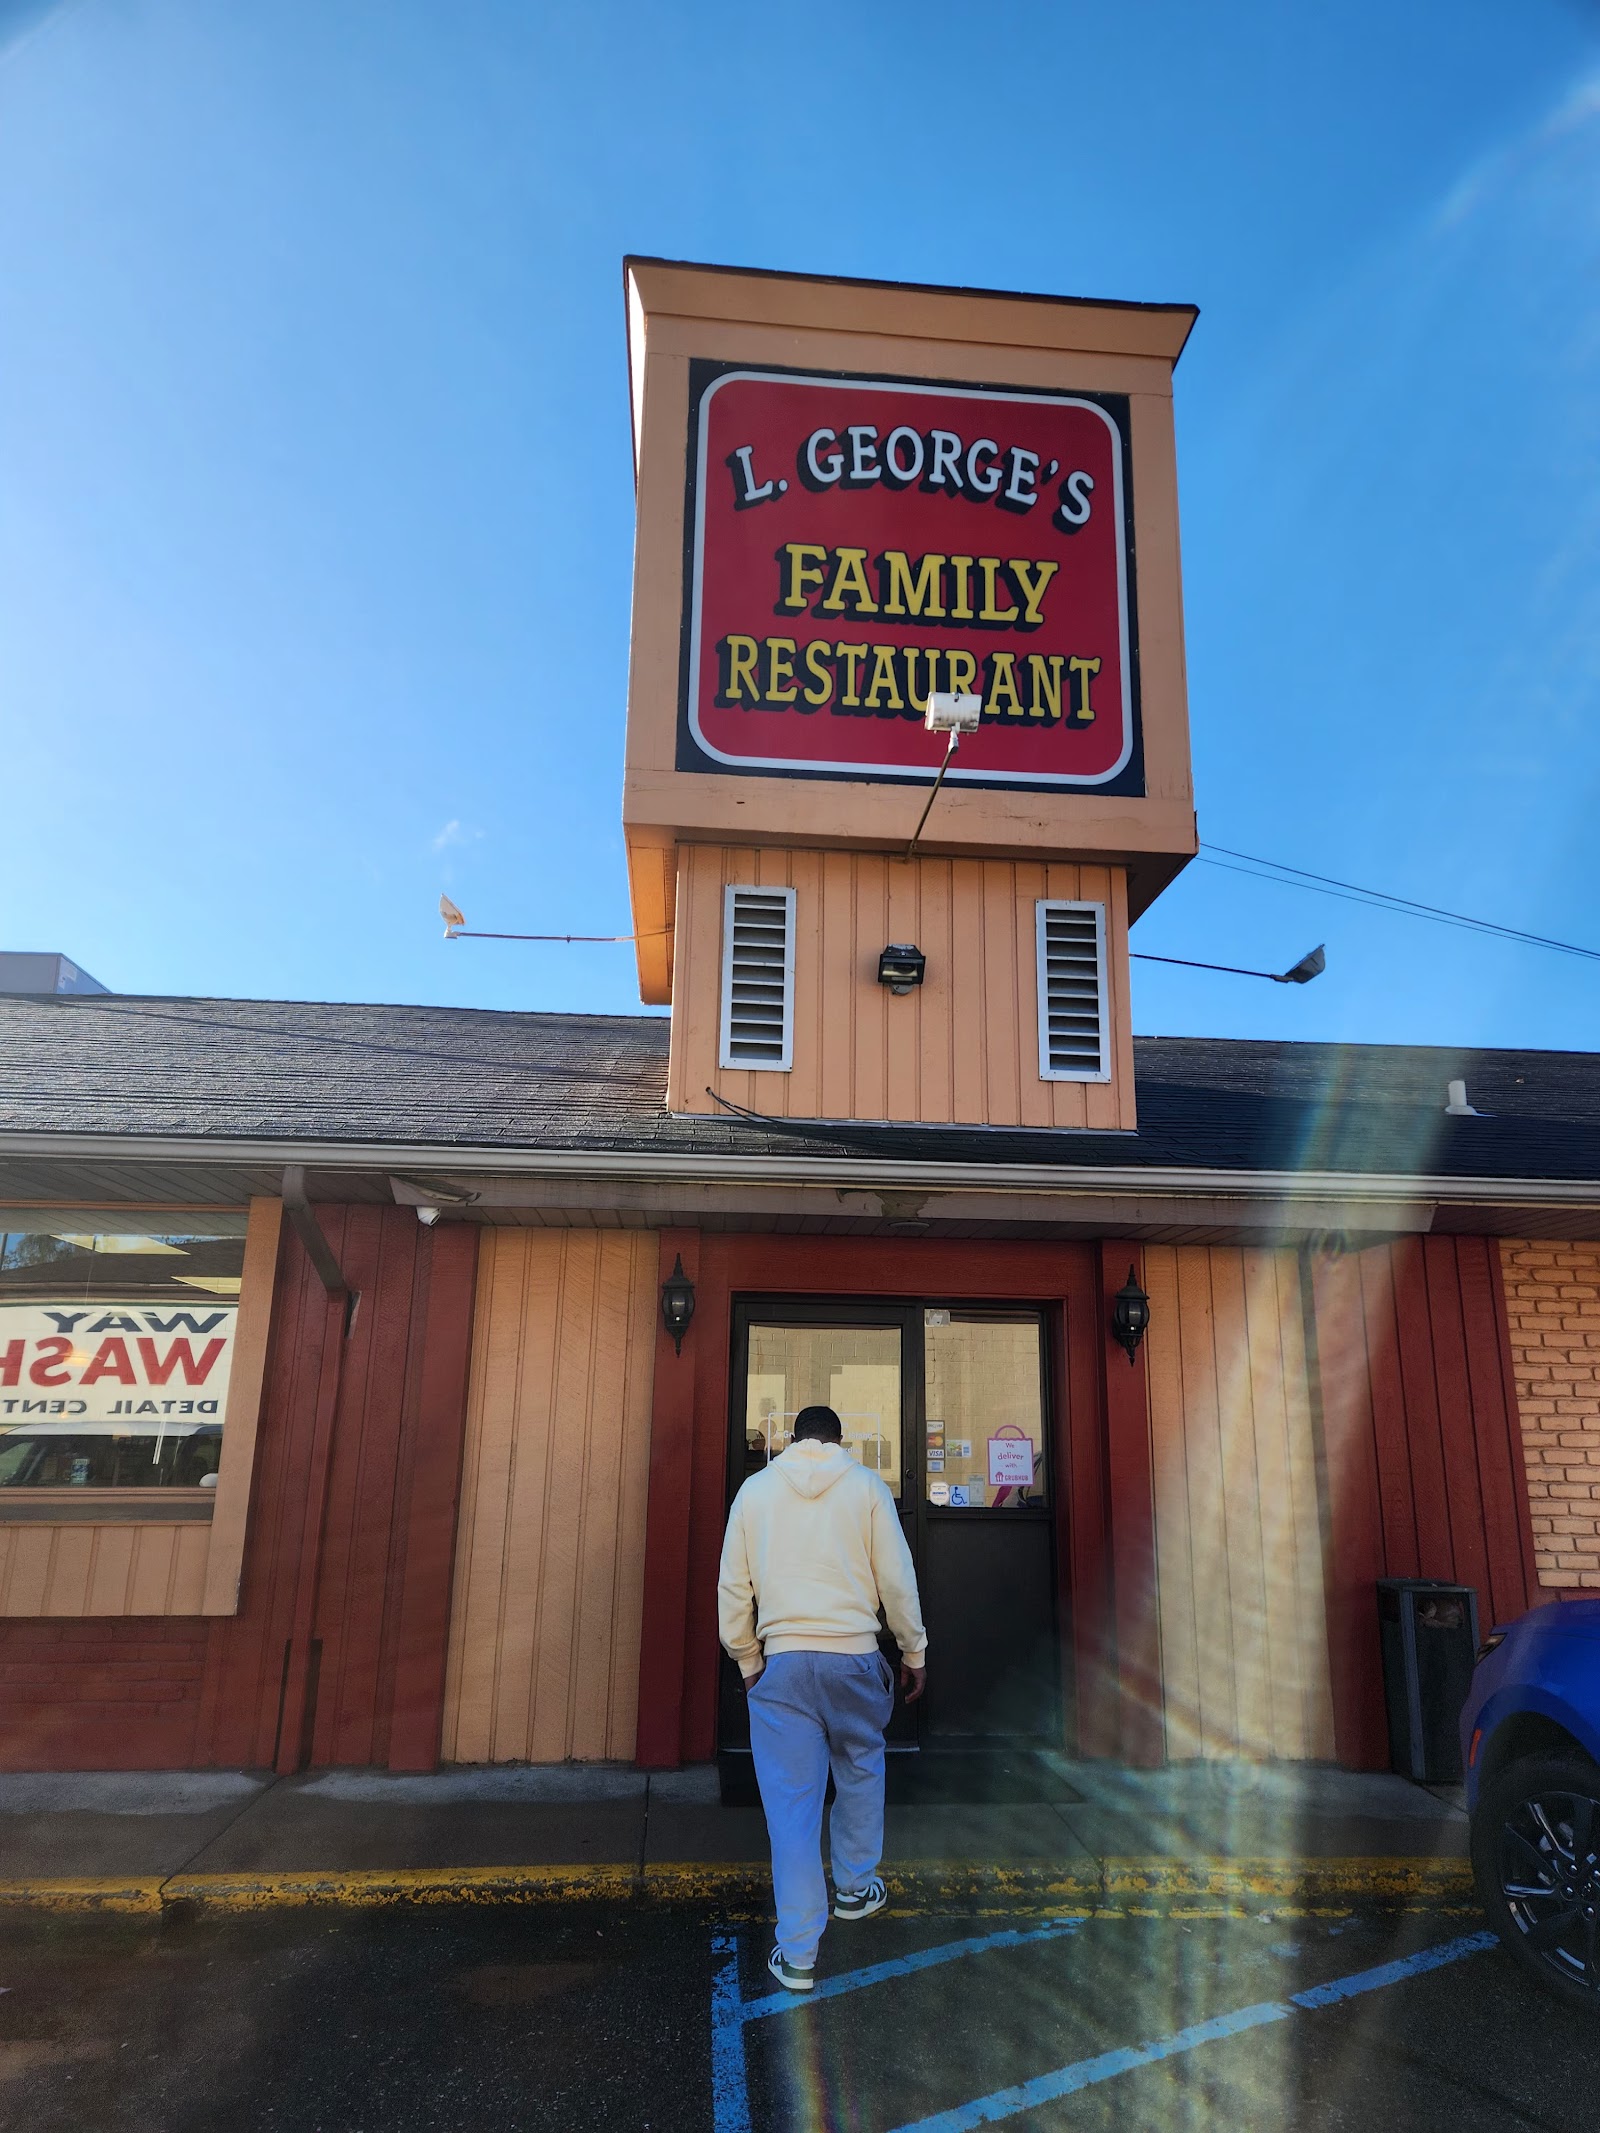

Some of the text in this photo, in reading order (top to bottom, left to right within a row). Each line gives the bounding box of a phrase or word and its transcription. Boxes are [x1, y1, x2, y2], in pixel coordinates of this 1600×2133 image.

[734, 425, 1096, 527] L. GEORGE'S
[782, 542, 1060, 625] FAMILY
[723, 634, 1103, 722] RESTAURANT
[997, 1451, 1024, 1460] deliver
